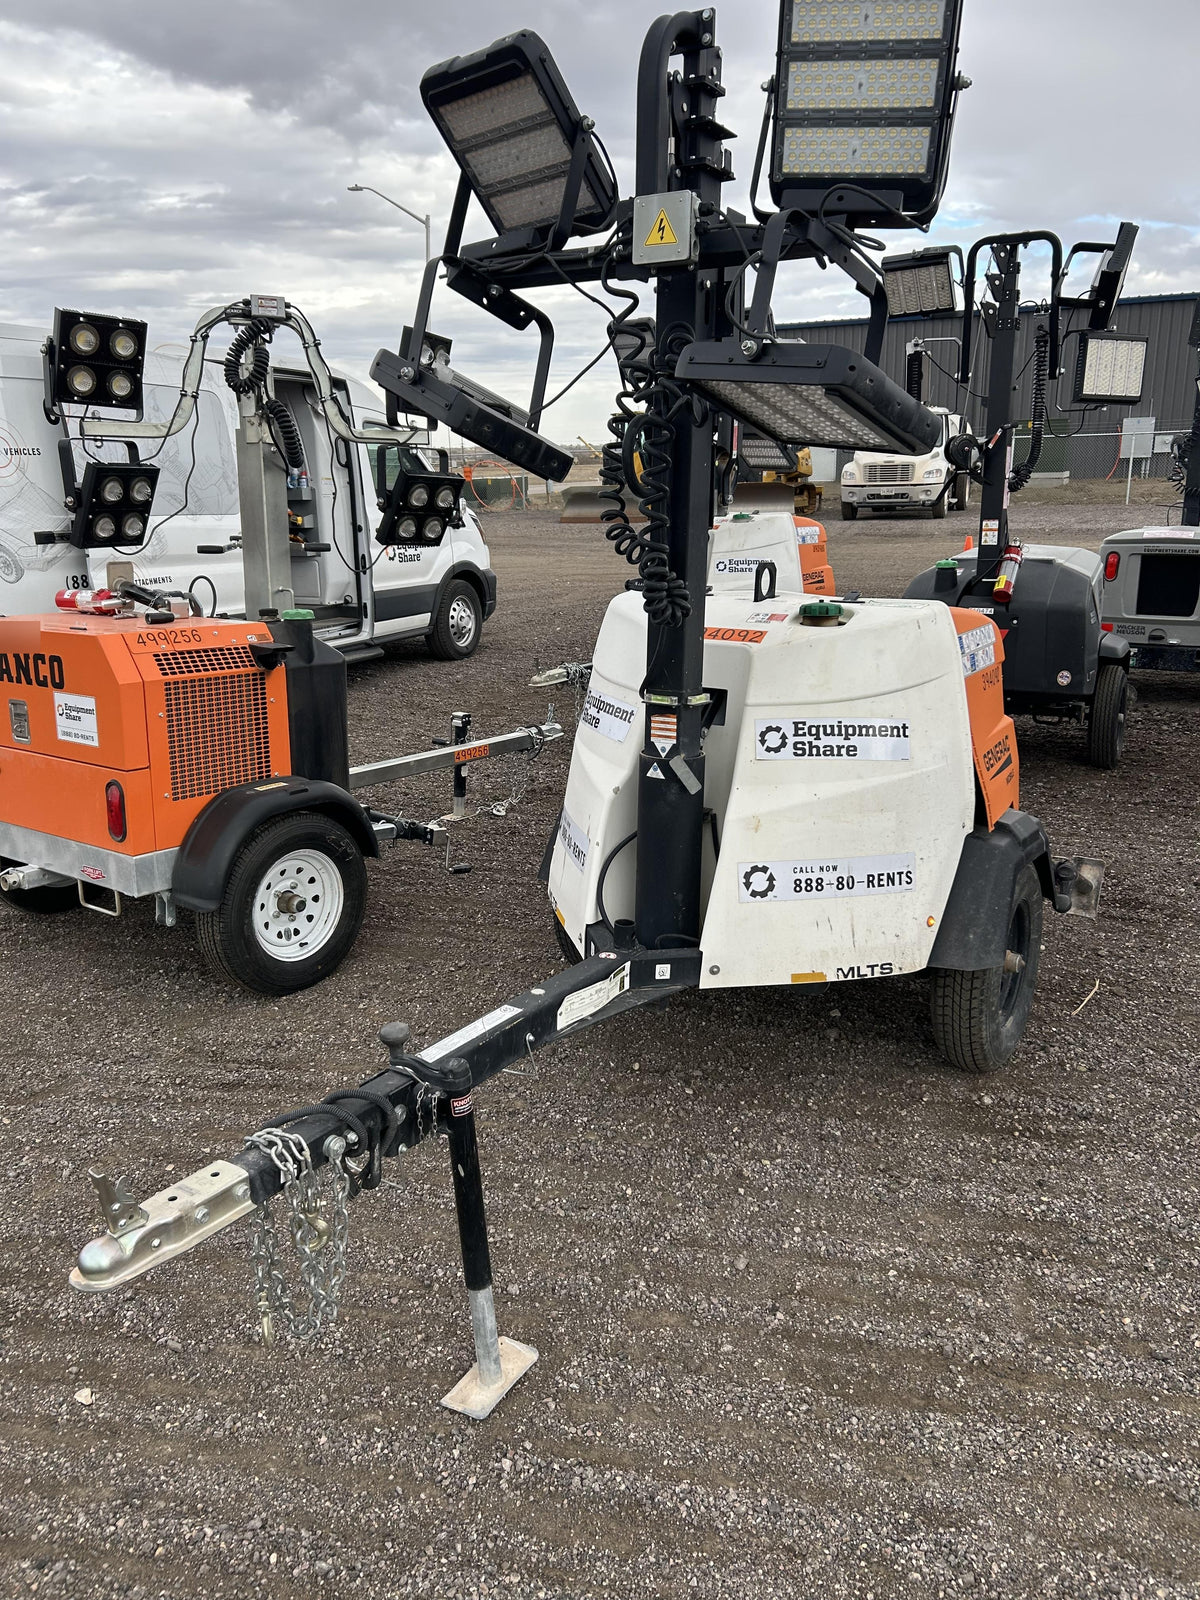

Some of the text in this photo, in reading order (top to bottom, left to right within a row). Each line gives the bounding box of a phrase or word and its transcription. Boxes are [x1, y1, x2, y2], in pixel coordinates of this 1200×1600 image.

[4, 448, 41, 456] VEHICLES
[398, 552, 421, 563] Share
[728, 558, 773, 566] Equipm
[135, 576, 172, 587] TTACHMENTS
[137, 629, 202, 647] 499256
[64, 703, 95, 716] Equipment
[65, 712, 82, 722] Share
[792, 721, 909, 741] Equipment
[455, 745, 489, 760] 499256
[792, 741, 858, 757] Share
[983, 734, 1010, 772] GENERAC
[792, 865, 839, 874] CALL NOW
[793, 870, 913, 893] 888-80-RENTS
[836, 962, 894, 980] MLTS
